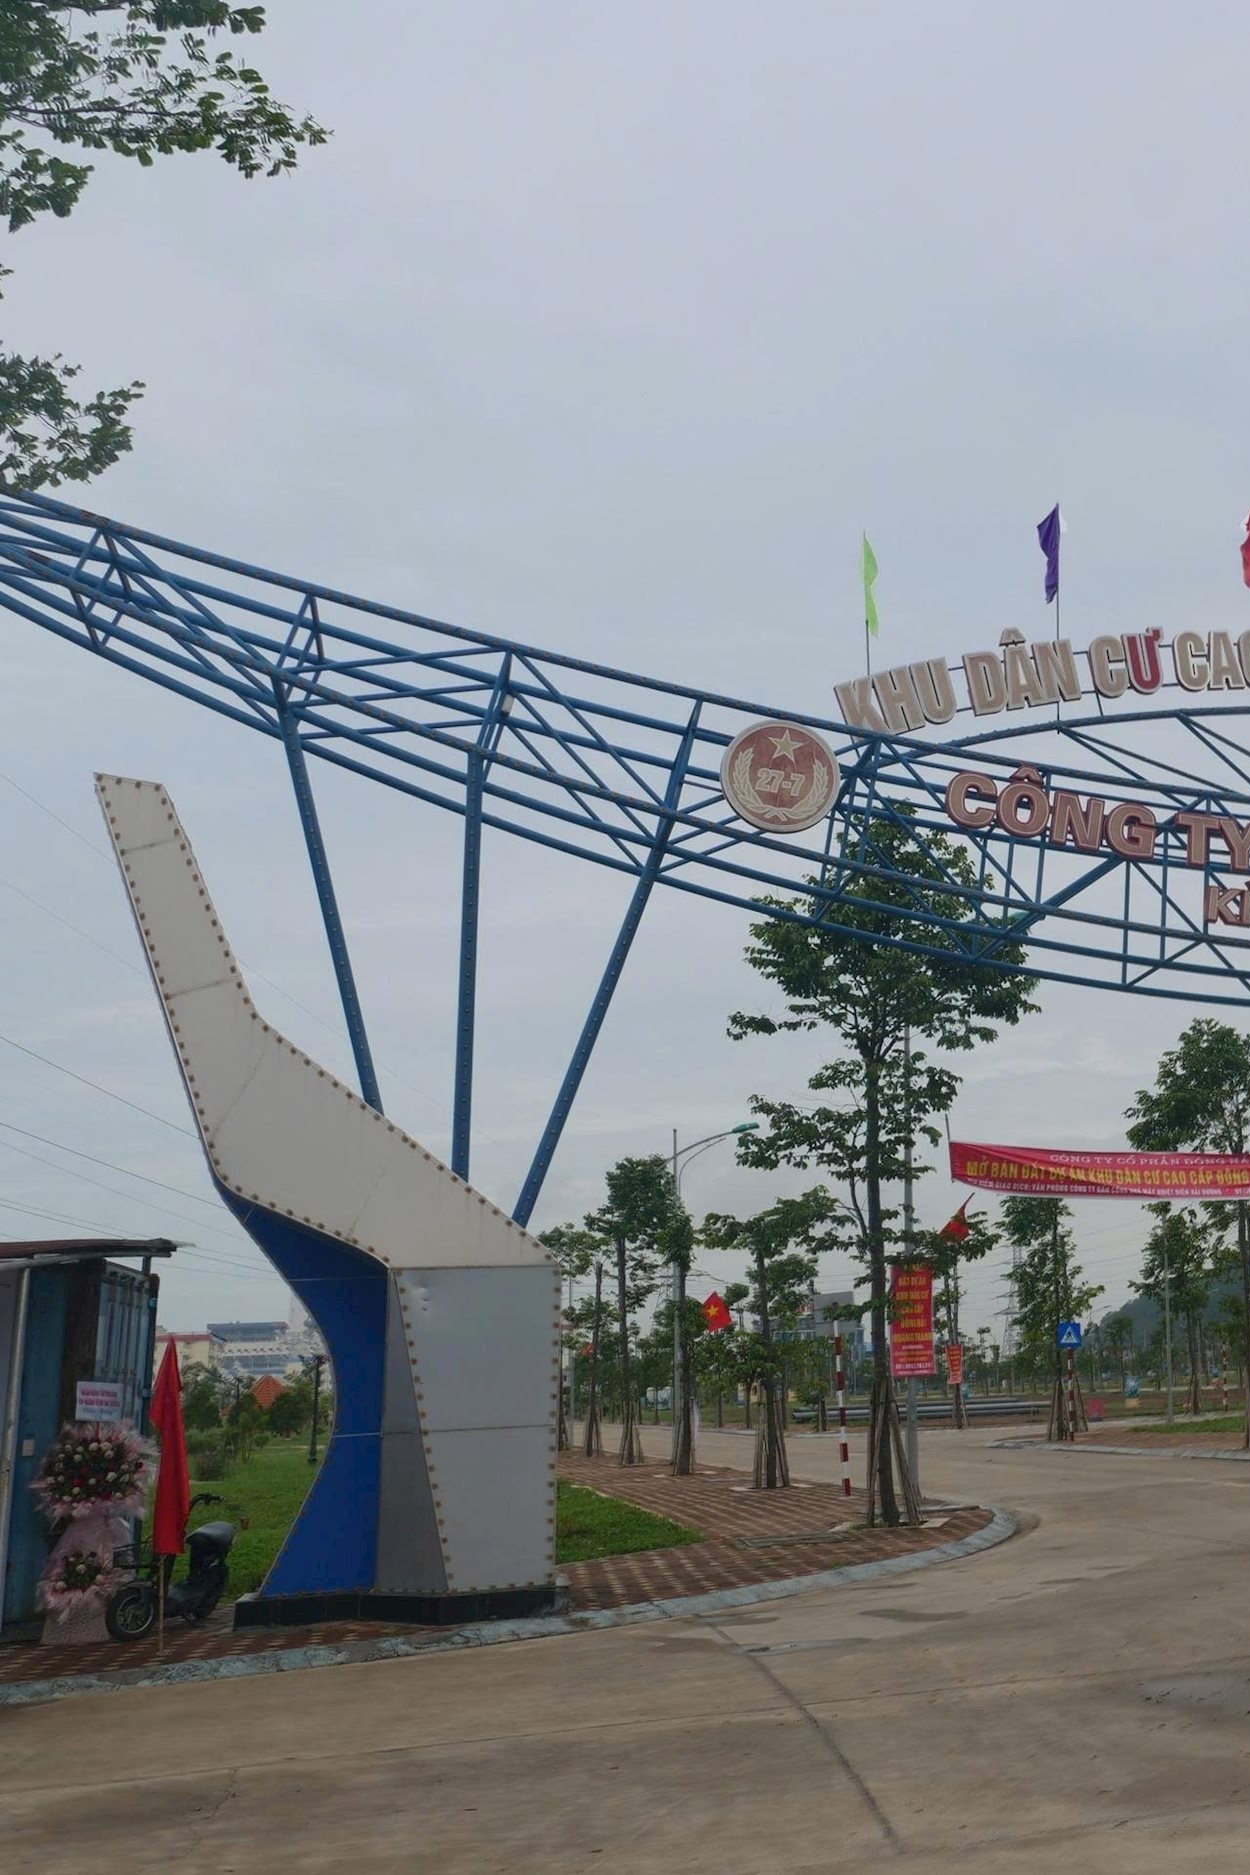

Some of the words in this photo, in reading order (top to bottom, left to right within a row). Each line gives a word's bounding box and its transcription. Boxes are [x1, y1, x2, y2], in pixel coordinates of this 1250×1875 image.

[834, 657, 957, 740] KHU
[962, 627, 1082, 717] DÂN
[1088, 627, 1164, 698] CƯ
[755, 768, 806, 796] 27-7
[946, 763, 1157, 860] CÔNG
[966, 1155, 988, 1176] MỞ
[1163, 1171, 1187, 1186] CAO
[1190, 1166, 1213, 1186] CẤP
[1094, 1156, 1111, 1164] TY
